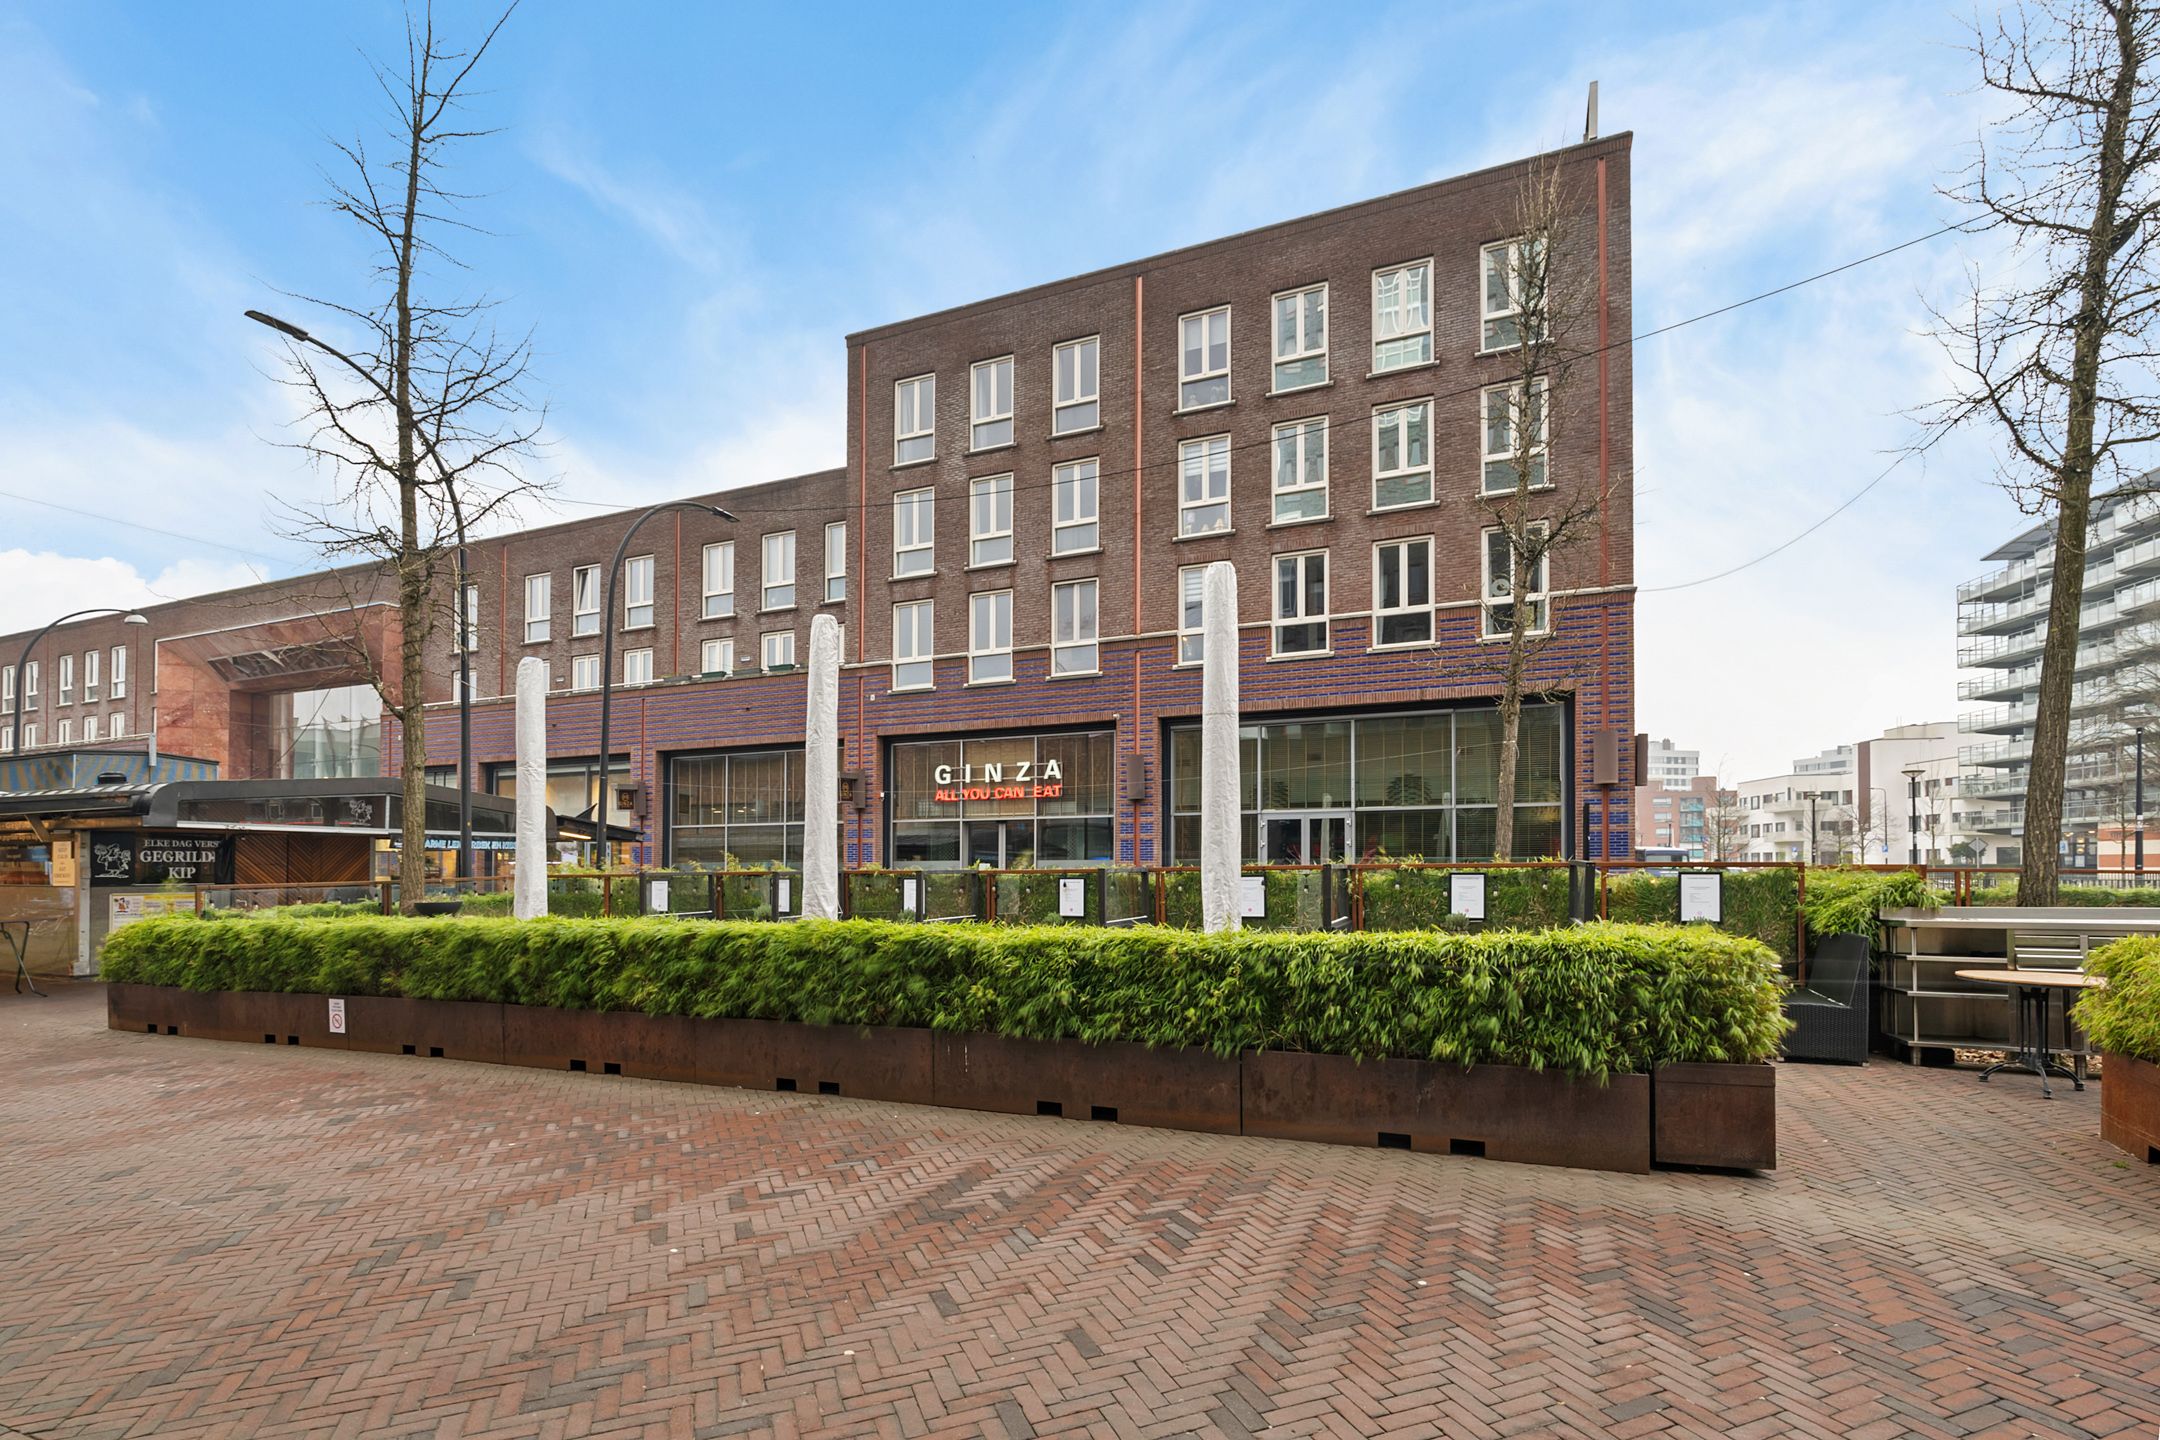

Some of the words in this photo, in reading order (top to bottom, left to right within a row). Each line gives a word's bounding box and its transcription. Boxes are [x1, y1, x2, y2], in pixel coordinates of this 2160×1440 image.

[934, 759, 1062, 785] GINZA
[935, 788, 959, 801] ALL
[961, 787, 991, 800] YOU
[993, 785, 1025, 799] CAN
[1032, 783, 1063, 798] EAT
[144, 839, 170, 847] ELKE
[172, 839, 193, 848] DAG
[194, 840, 219, 848] VERS
[168, 866, 196, 879] KIP
